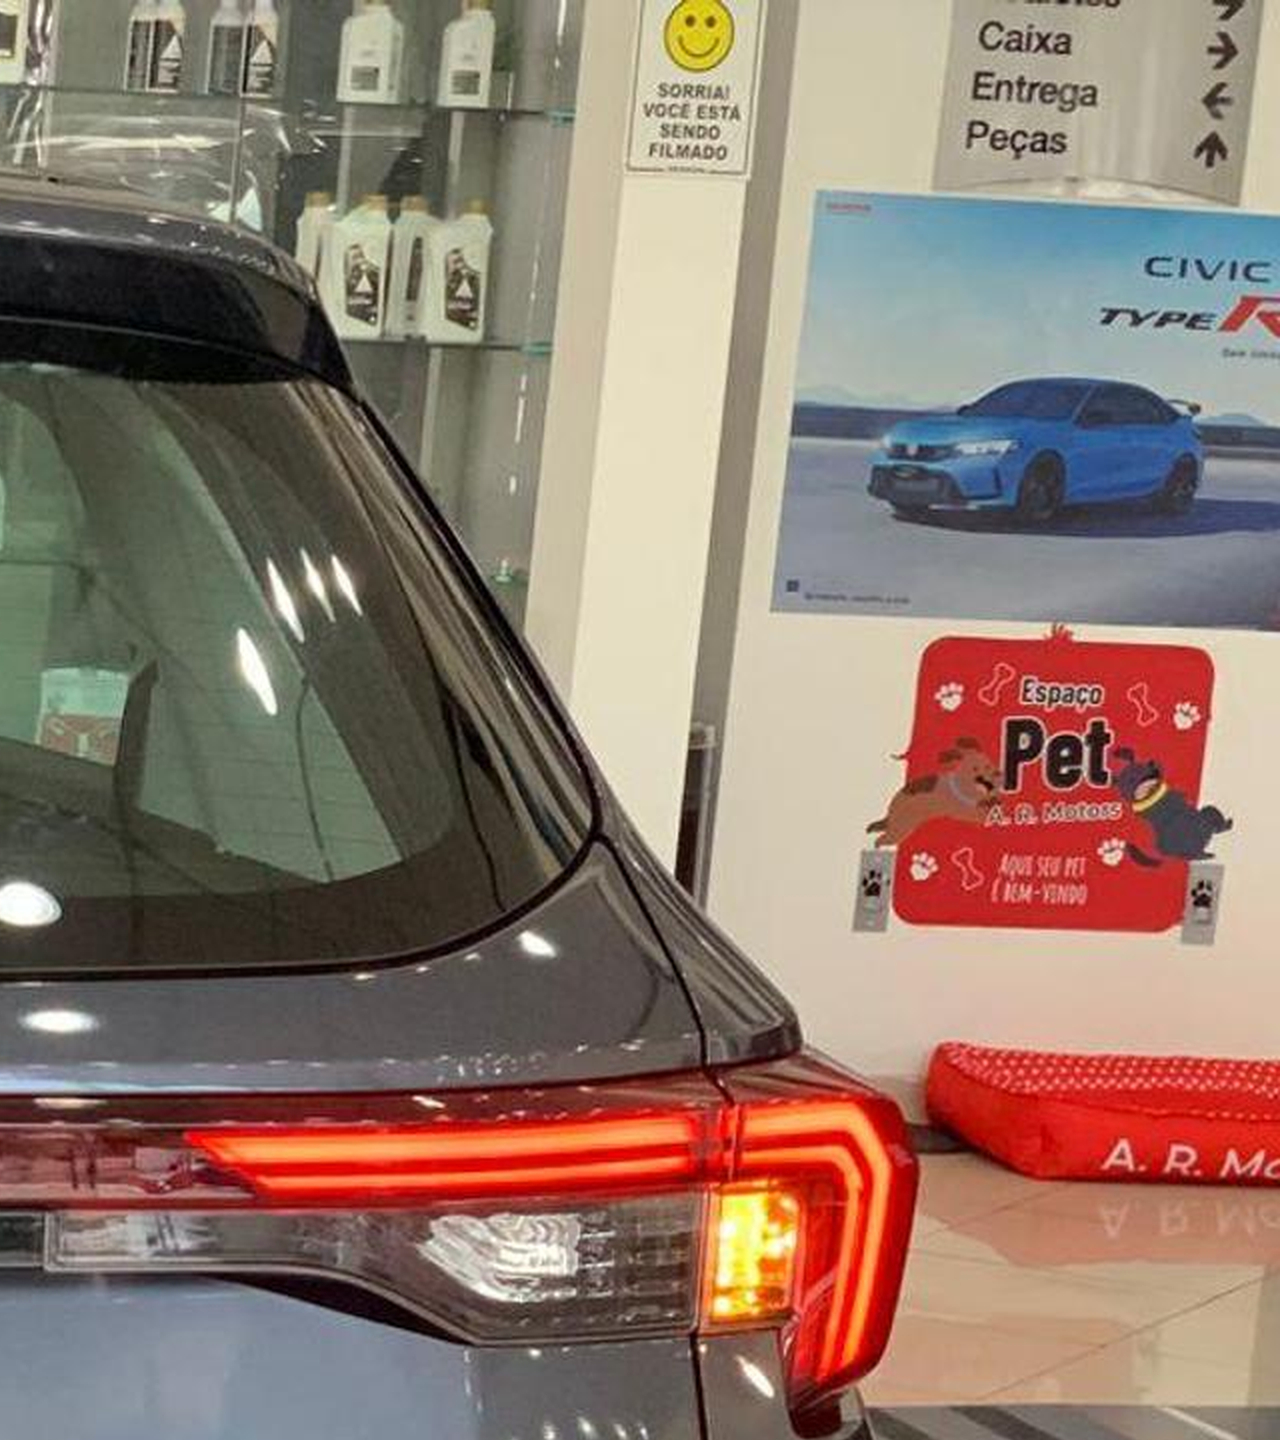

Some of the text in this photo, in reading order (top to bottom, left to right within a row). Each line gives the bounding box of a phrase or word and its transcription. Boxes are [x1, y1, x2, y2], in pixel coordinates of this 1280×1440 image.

[978, 20, 1072, 55] Caixa
[657, 83, 731, 101] SORRIA!
[971, 71, 1099, 113] Entrega
[659, 122, 721, 140] SENDO
[965, 120, 1068, 160] Peças
[648, 142, 728, 161] FILMADO
[1144, 256, 1272, 284] CIVIC
[1099, 306, 1217, 332] TYPE
[1020, 676, 1104, 711] Espaço
[1002, 717, 1113, 792] Pet
[1043, 801, 1122, 824] Motors
[1100, 1137, 1147, 1172] A.
[1163, 1143, 1202, 1176] R.
